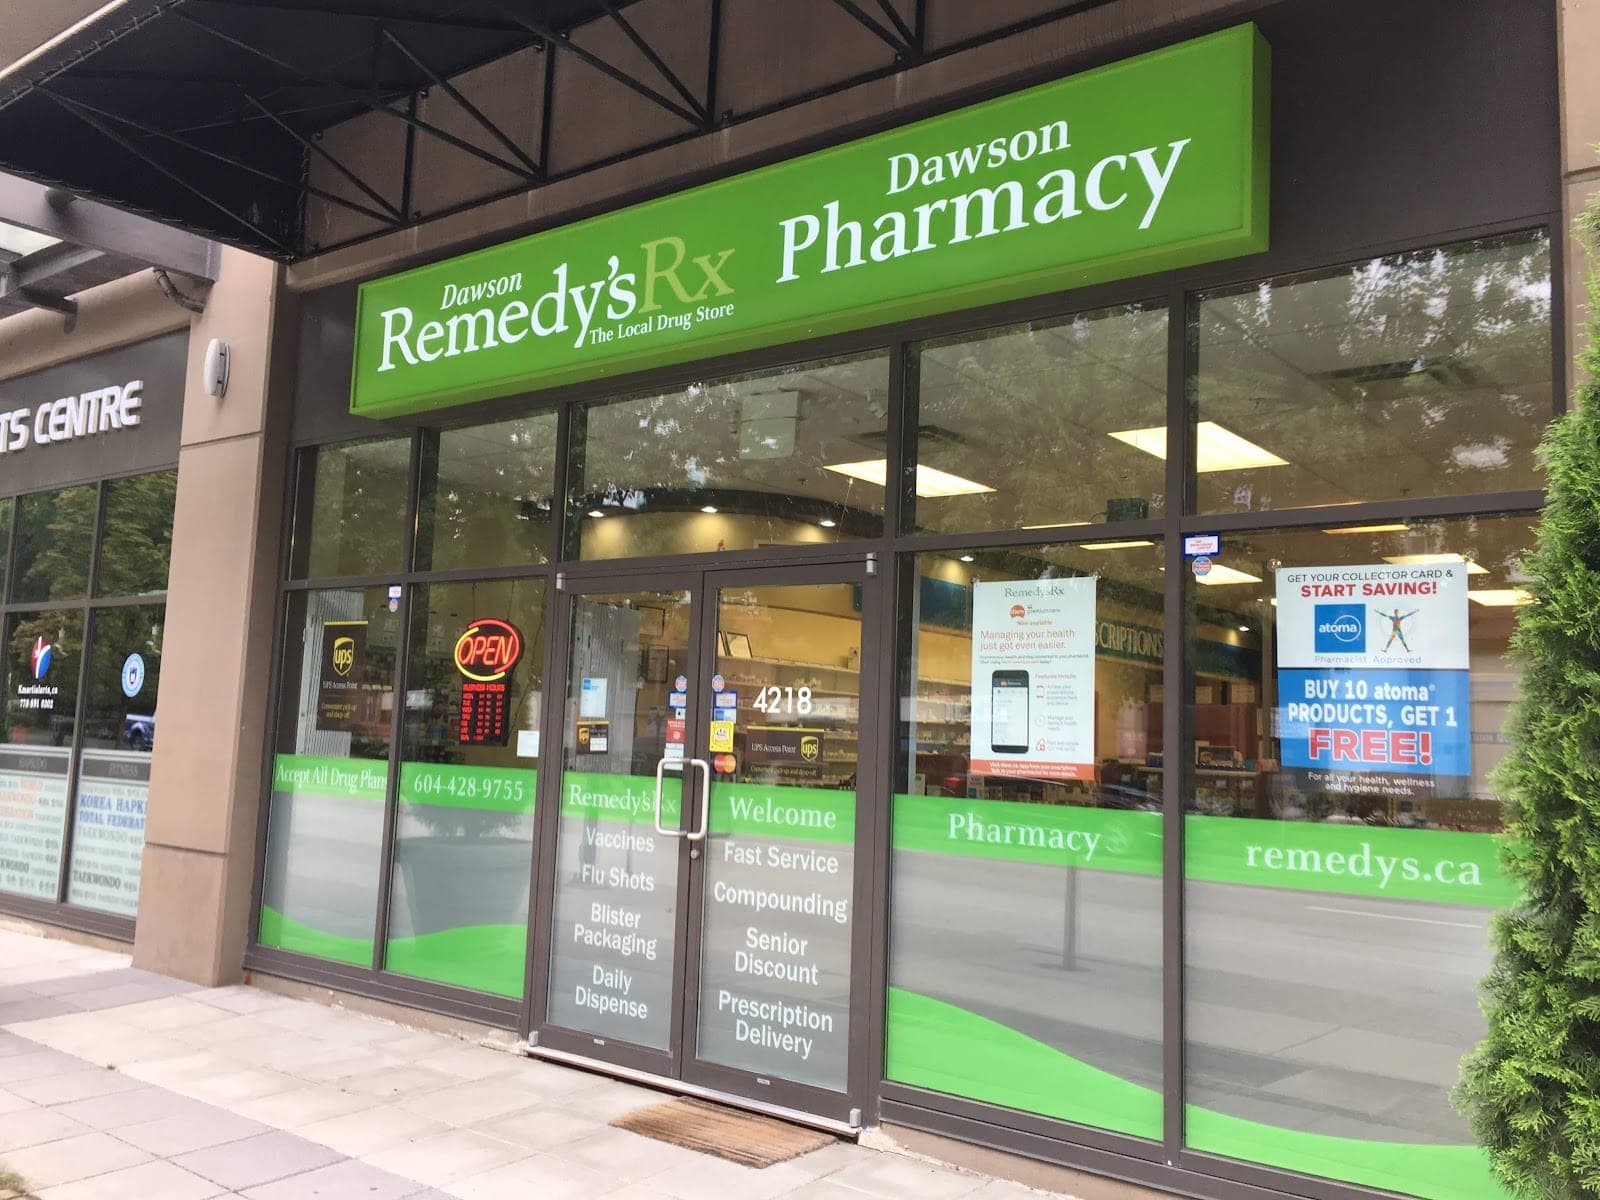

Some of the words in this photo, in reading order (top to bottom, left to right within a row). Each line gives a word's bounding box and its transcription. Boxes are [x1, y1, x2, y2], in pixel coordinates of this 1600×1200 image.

[885, 119, 1071, 195] Dawson
[775, 137, 1191, 284] Pharmacy
[440, 272, 522, 310] Dawson
[590, 328, 613, 345] The
[617, 316, 652, 341] Local
[657, 311, 692, 336] Drug
[696, 300, 735, 323] Store
[34, 380, 144, 445] CENTRE
[1287, 574, 1307, 583] GET
[1311, 573, 1339, 583] YOUR
[1342, 570, 1407, 582] COLLECTOR
[1410, 569, 1442, 579] CARD
[1445, 569, 1454, 578] &
[1301, 584, 1356, 598] START
[1362, 581, 1437, 597] SAVING!
[980, 629, 1024, 641] Managing
[1026, 631, 1044, 640] your
[1046, 628, 1075, 639] health
[1319, 623, 1357, 634] atoma
[459, 636, 514, 666] OPEN
[980, 642, 997, 652] just
[999, 641, 1014, 653] got
[1016, 642, 1035, 651] even
[1314, 655, 1366, 664] Pharmacist
[1373, 656, 1422, 666] Approved
[753, 686, 812, 715] 4218
[1304, 680, 1339, 699] BUY
[1345, 681, 1367, 700] 10
[1288, 703, 1394, 729] PRODUCTS,
[1401, 705, 1440, 727] GET
[1445, 706, 1458, 727] 1
[751, 742, 763, 752] UPS
[802, 743, 817, 758] ups
[1308, 727, 1433, 765] FREE!
[277, 764, 310, 790] Accept
[312, 765, 328, 785] All
[330, 767, 358, 795] Drug
[414, 774, 524, 802] 604-428-9755
[1308, 771, 1321, 781] For
[1325, 774, 1335, 782] all
[1337, 775, 1356, 785] your
[1393, 778, 1435, 788] wellness
[1325, 782, 1341, 791] and
[1344, 783, 1379, 794] hygiene
[79, 793, 112, 810] KOREA
[729, 796, 836, 831] Welcome
[586, 826, 655, 853] Vaccines
[948, 811, 1101, 862] Pharmacy
[724, 842, 762, 867] Fast
[767, 845, 839, 875] Service
[1246, 842, 1482, 889] remedys.ca
[582, 864, 605, 886] Flu
[609, 866, 655, 892] Shots
[591, 903, 641, 930] Blister
[714, 881, 848, 924] Compounding
[574, 924, 657, 961] Packaging
[746, 926, 809, 957] Senior
[593, 964, 632, 995] Daily
[735, 951, 819, 986] Discount
[575, 986, 648, 1020] Dispense
[718, 990, 833, 1033] Prescription
[735, 1019, 813, 1061] Delivery
